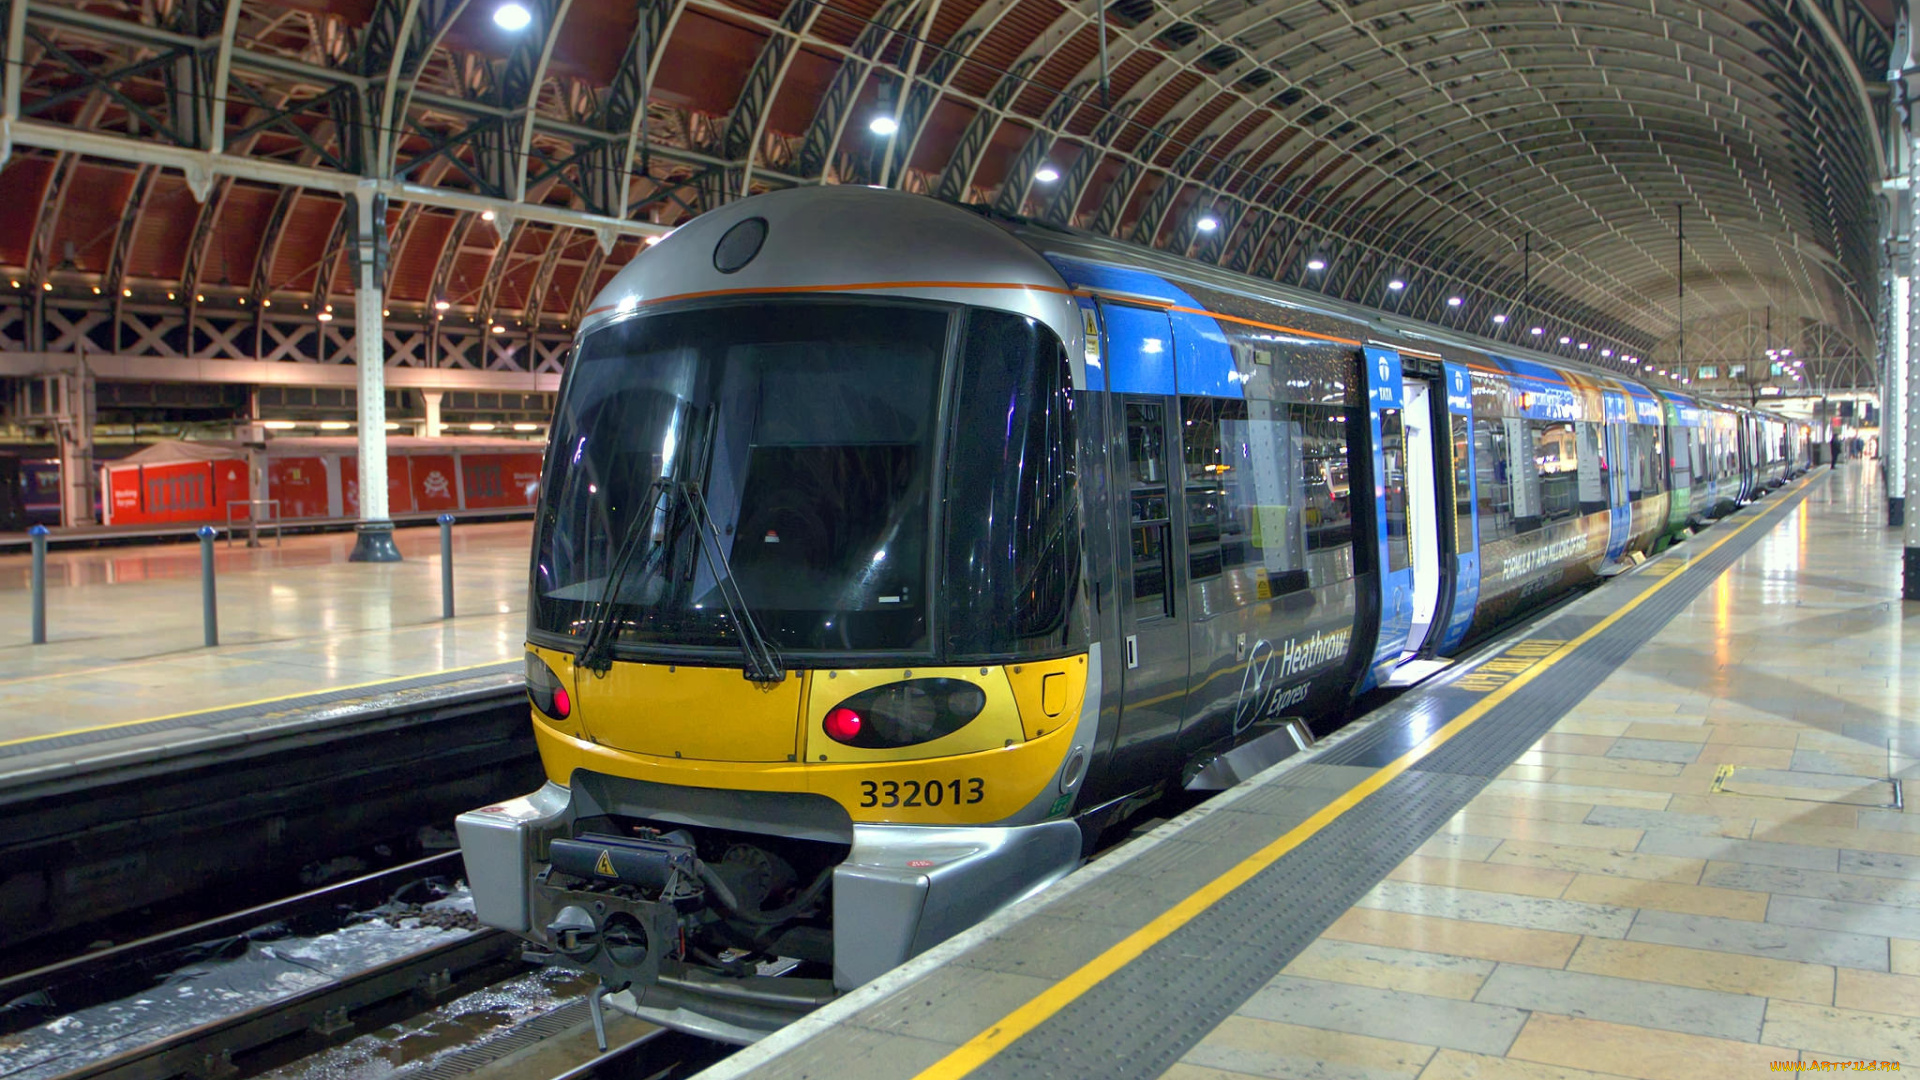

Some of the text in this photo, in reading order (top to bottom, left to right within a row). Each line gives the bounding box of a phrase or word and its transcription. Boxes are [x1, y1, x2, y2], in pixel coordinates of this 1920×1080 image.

[1379, 387, 1393, 401] TATA
[1280, 630, 1347, 678] Heathrow
[1449, 673, 1513, 692] GAP
[1266, 681, 1311, 716] Express
[860, 777, 985, 808] 332013
